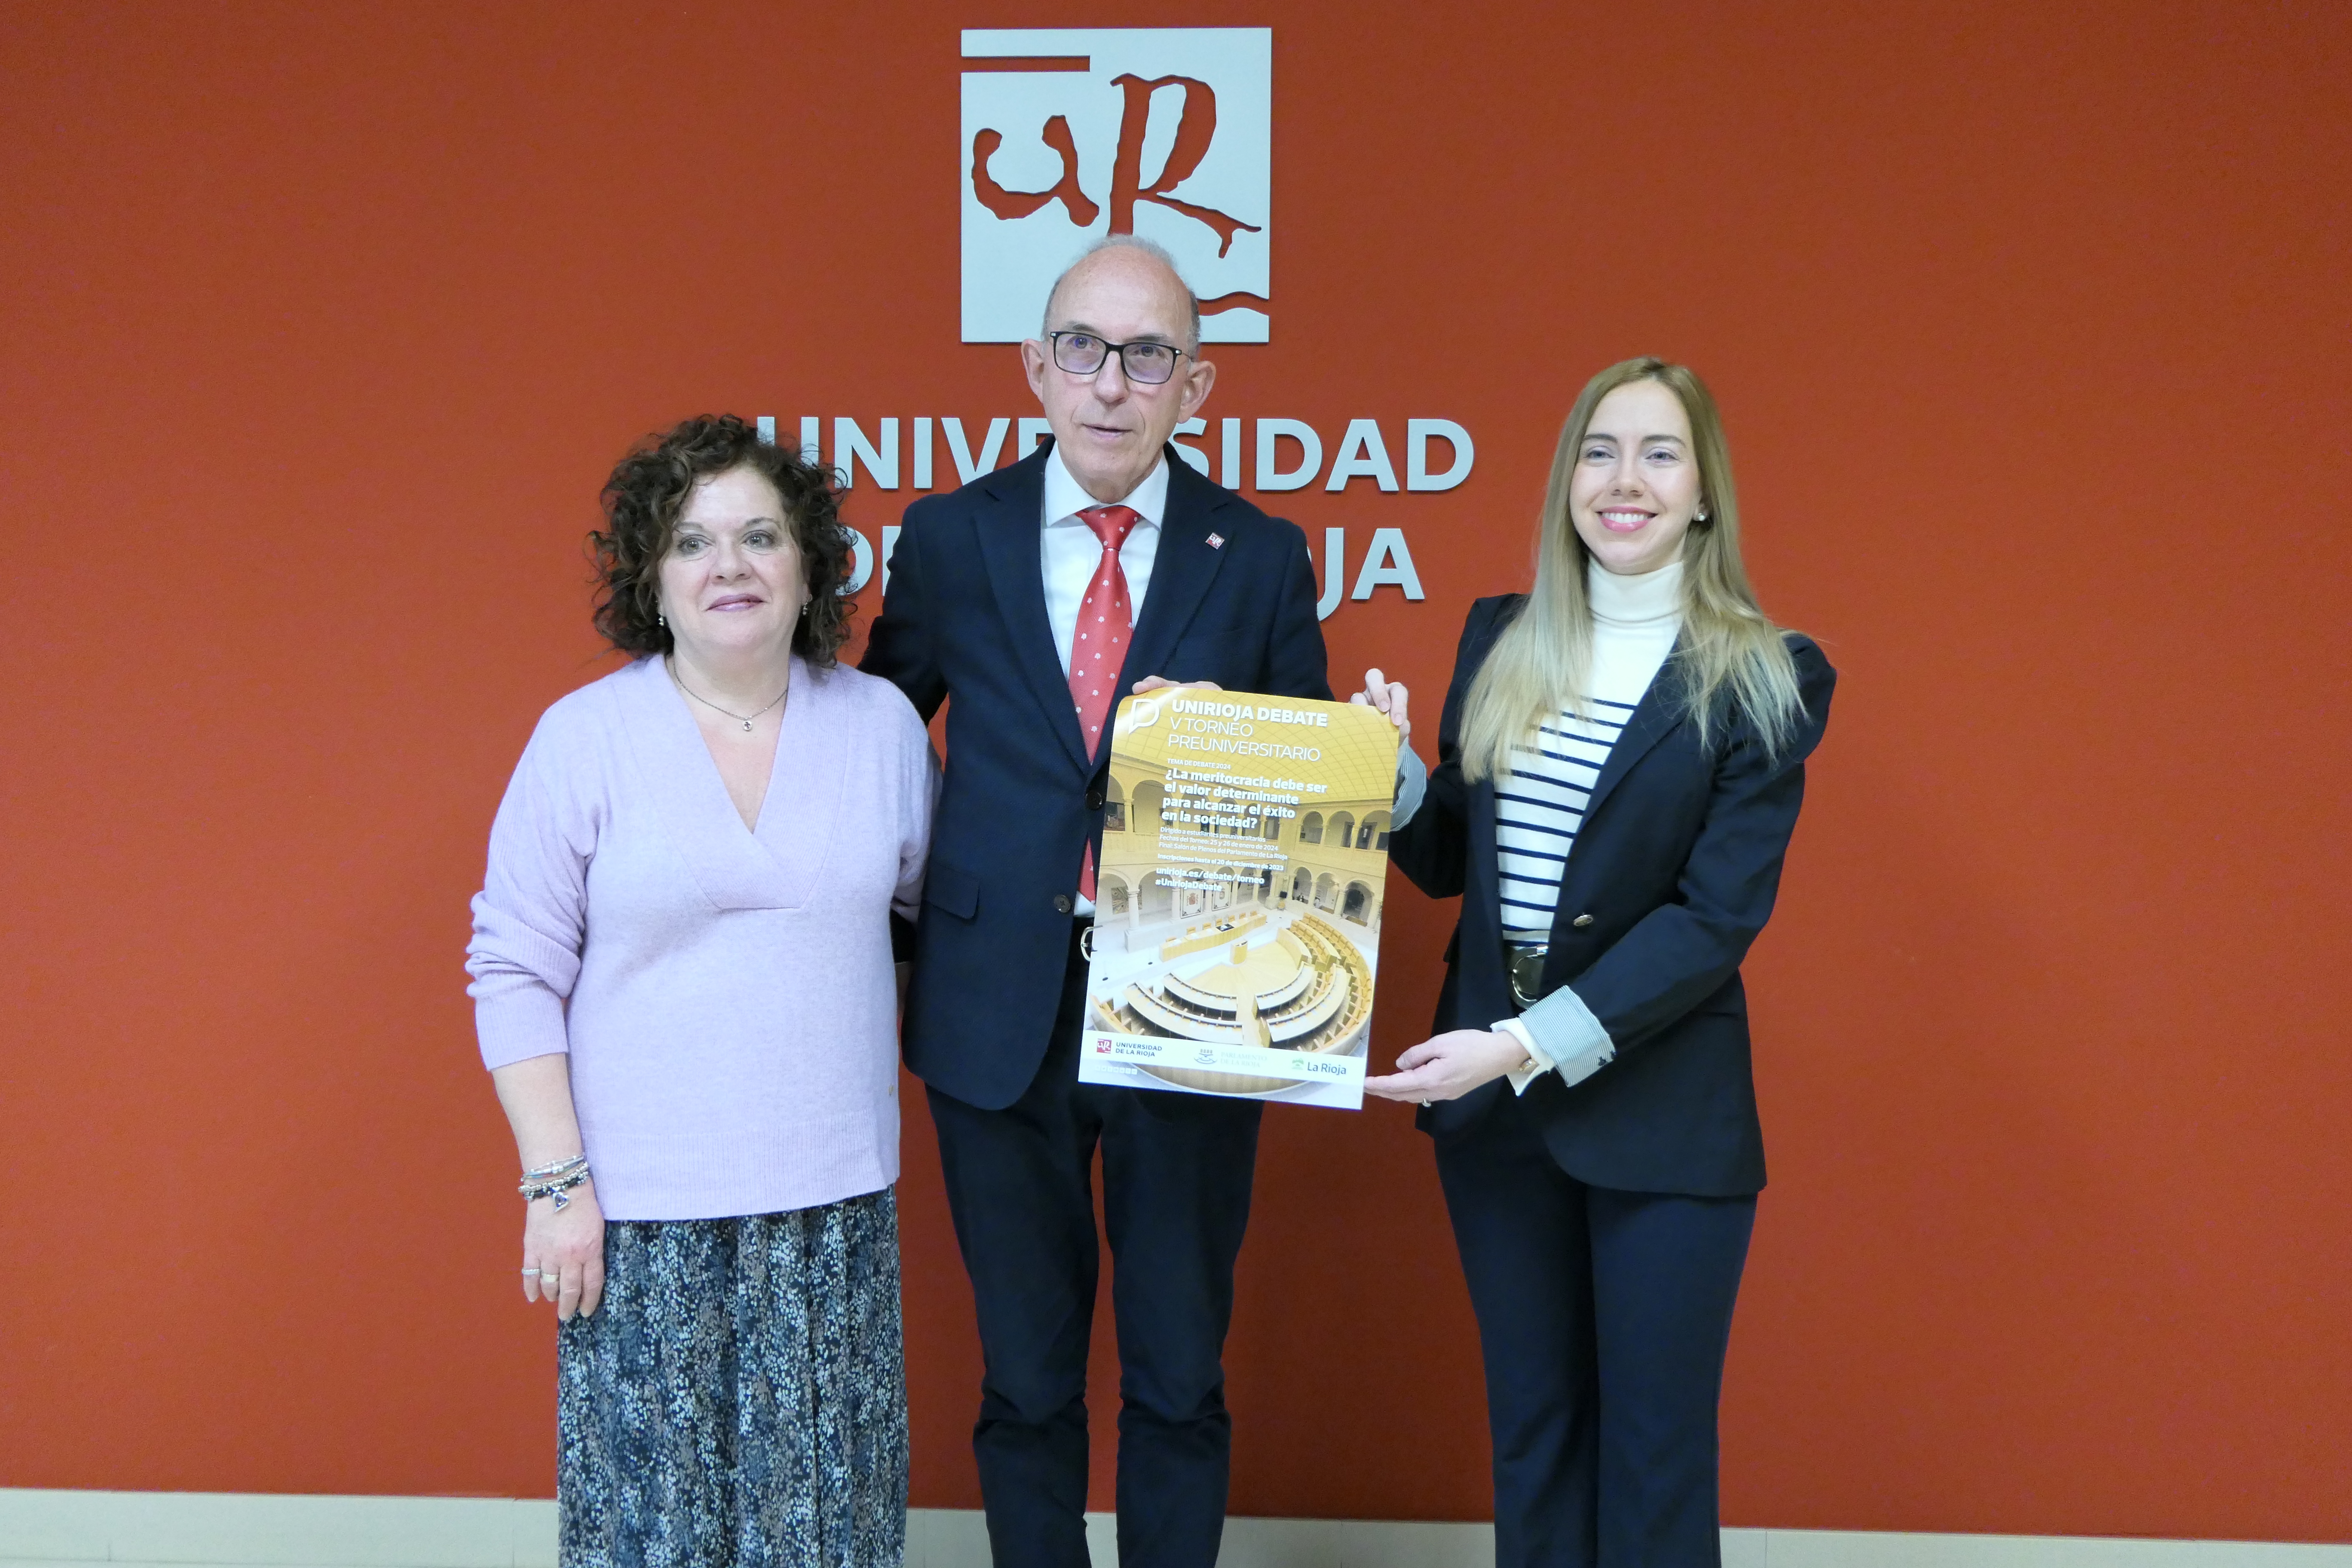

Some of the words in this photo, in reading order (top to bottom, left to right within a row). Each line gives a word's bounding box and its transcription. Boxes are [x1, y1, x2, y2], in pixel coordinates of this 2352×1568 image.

[757, 416, 1474, 491] NIVSIDAD
[1172, 699, 1254, 722] UNIRIOJA
[1257, 707, 1328, 727] DEBATE
[1170, 717, 1182, 730] V
[1185, 718, 1253, 737] TORNEO
[1168, 734, 1321, 761] PREUNIVERSITARIO
[1165, 768, 1188, 780] ¿La
[1191, 772, 1271, 787] meritocracia
[1273, 778, 1304, 791] debe
[1306, 783, 1327, 793] ser
[1164, 781, 1176, 793] el
[1179, 784, 1211, 796] valor
[1213, 786, 1299, 805] determinante
[1163, 797, 1191, 808] para
[1193, 798, 1247, 813] alcanzar
[1249, 804, 1261, 815] el
[1262, 805, 1295, 818] éxito
[1161, 811, 1177, 821] en
[1179, 810, 1191, 822] la
[1193, 814, 1257, 829] sociedad?
[1219, 833, 1266, 842] preuniversitarios
[1158, 854, 1194, 862] Inscripciones
[1155, 878, 1222, 891] #UniriojaDebate
[1156, 867, 1265, 884] unirioja.es/debate/torneo
[1116, 1042, 1162, 1051] UNIVERSIDAD
[1307, 1062, 1318, 1072] La
[1321, 1063, 1346, 1075] Rioja
